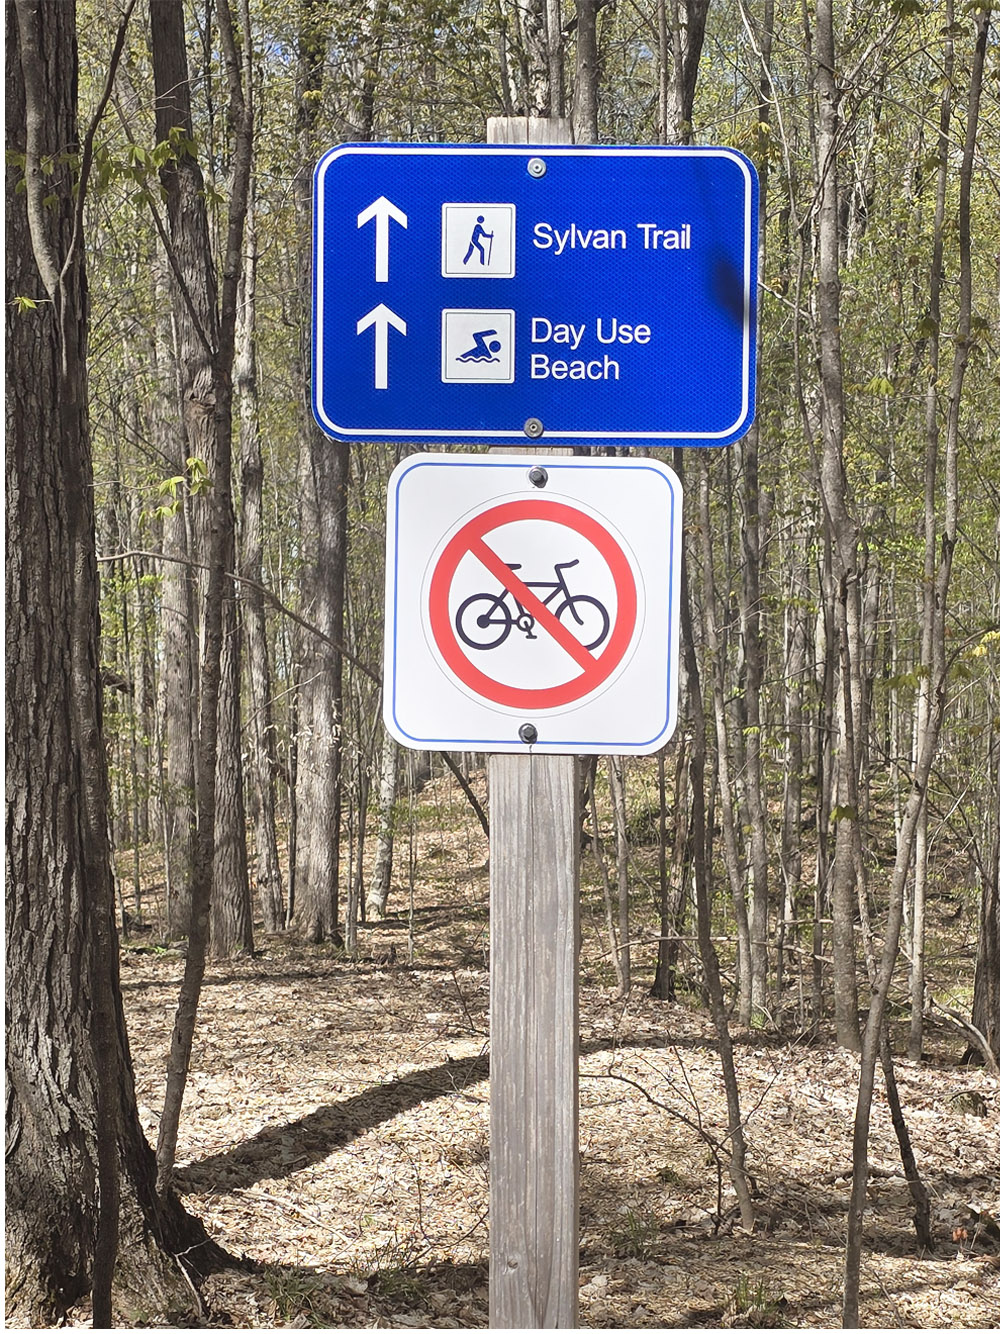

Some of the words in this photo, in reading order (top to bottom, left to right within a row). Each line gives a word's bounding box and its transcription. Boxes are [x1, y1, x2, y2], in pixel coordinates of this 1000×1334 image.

[532, 222, 627, 255] Sylvan
[637, 223, 691, 250] Trail
[531, 317, 585, 350] Day
[596, 318, 652, 344] Use
[530, 354, 620, 380] Beach
